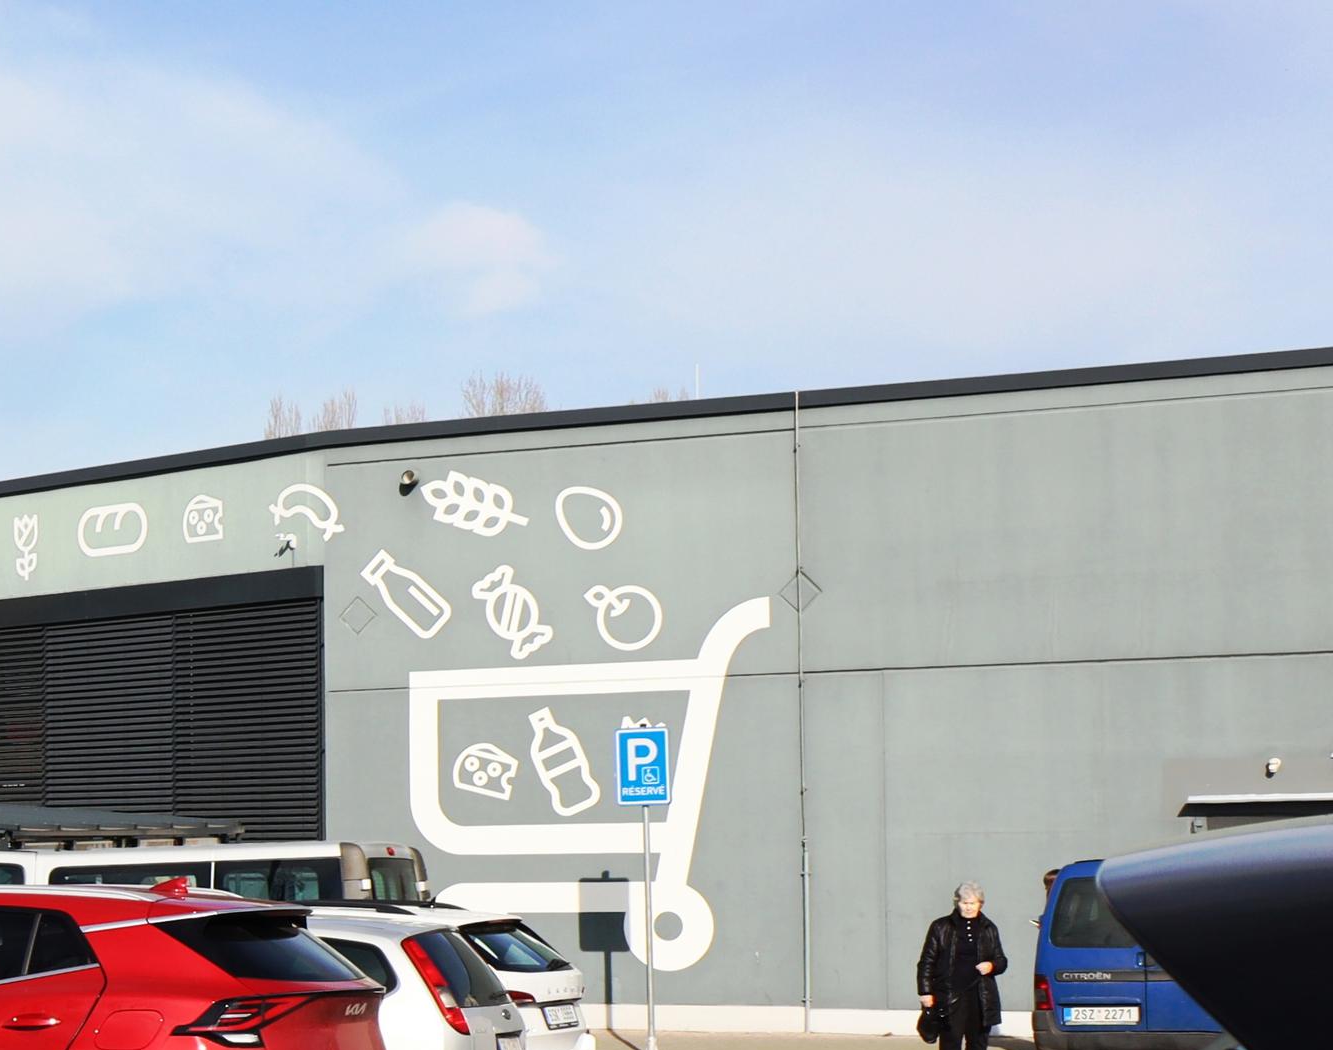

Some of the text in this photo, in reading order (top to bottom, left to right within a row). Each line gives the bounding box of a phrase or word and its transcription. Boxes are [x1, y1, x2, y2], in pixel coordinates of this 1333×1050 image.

[627, 738, 658, 781] P
[622, 784, 665, 796] RÉSERVÉ
[1062, 972, 1111, 980] CITROËN
[345, 1002, 367, 1016] KIA
[1073, 1008, 1132, 1020] 2SZ 2271
